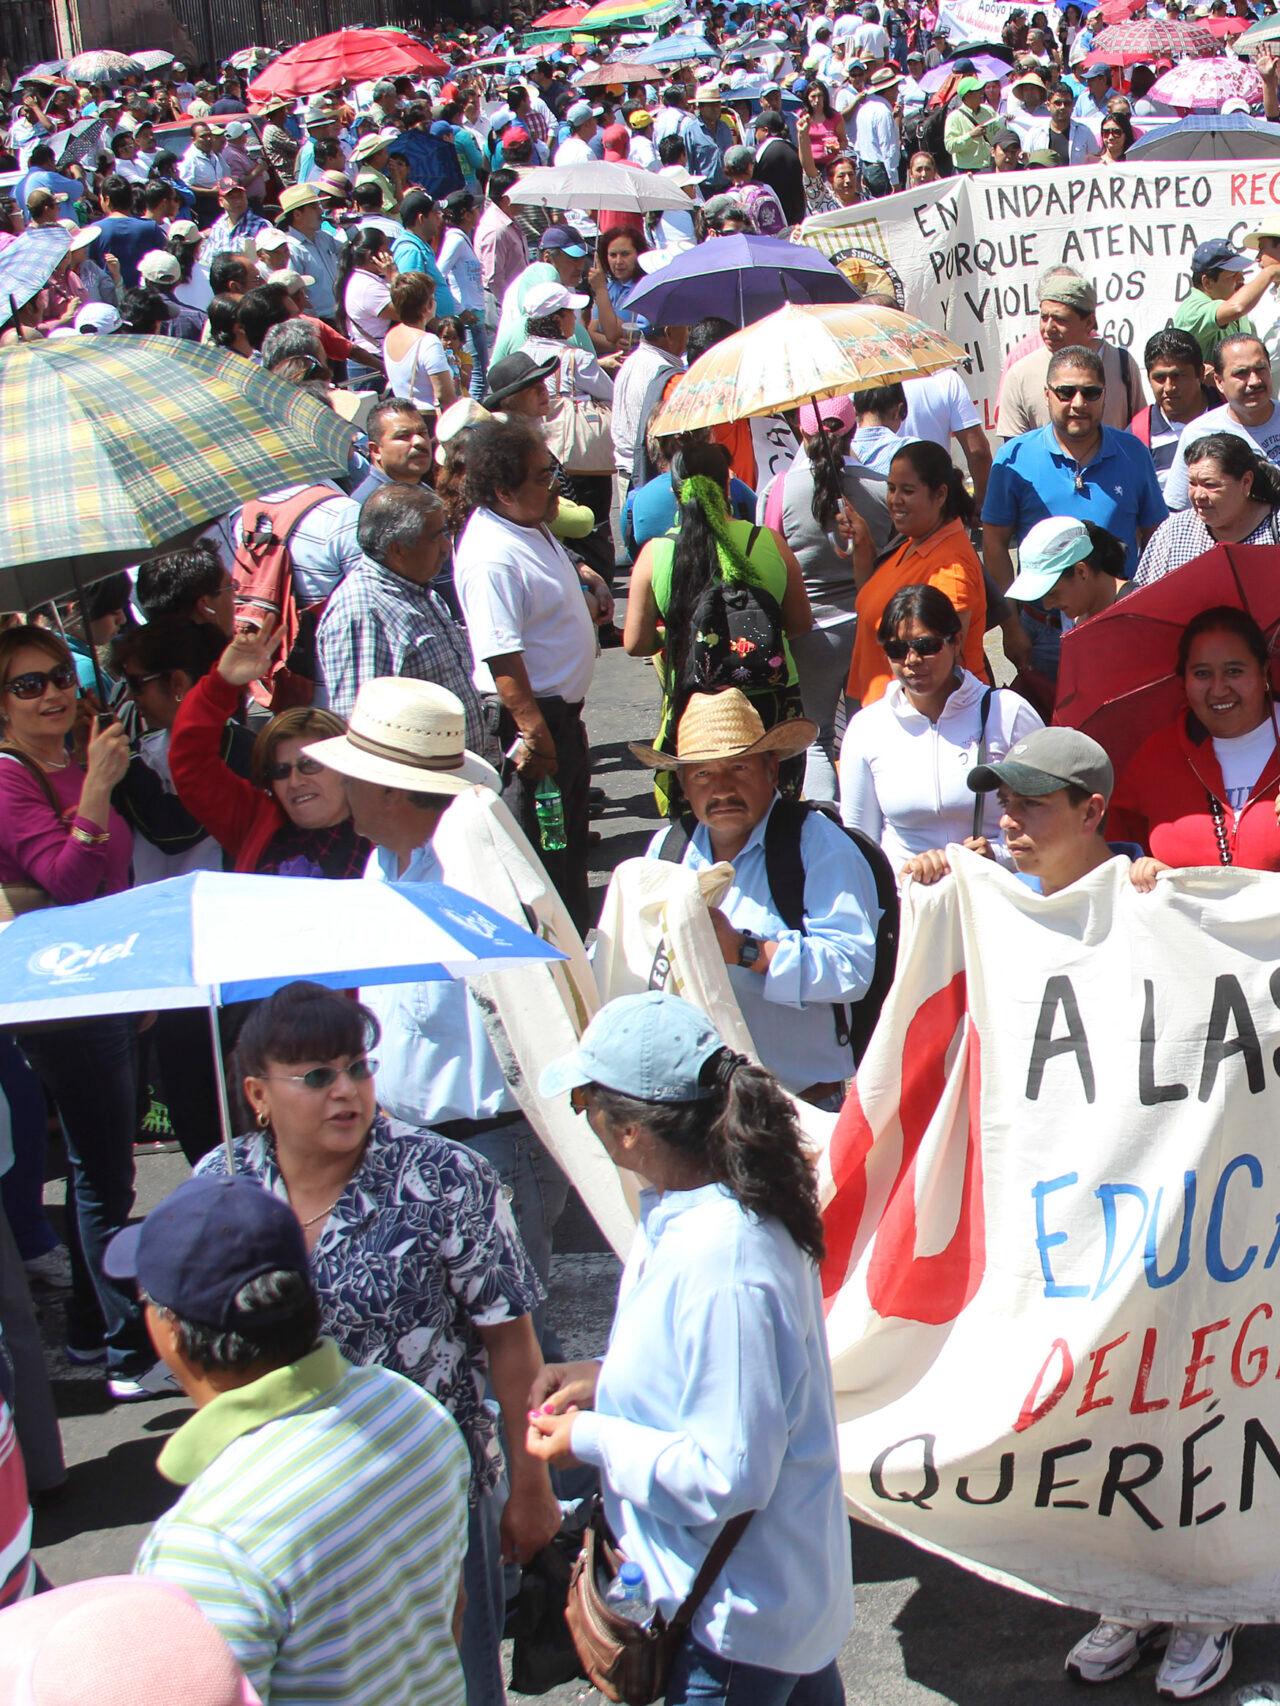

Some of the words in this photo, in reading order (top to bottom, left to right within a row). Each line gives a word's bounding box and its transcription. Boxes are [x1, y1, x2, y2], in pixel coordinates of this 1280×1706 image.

[913, 197, 959, 238] EN
[985, 175, 1212, 221] INDAPARAPEO
[929, 231, 1039, 285] PORQUE
[1061, 223, 1199, 264] ATENTA
[52, 931, 141, 977] Ciel
[1024, 974, 1096, 1104] A
